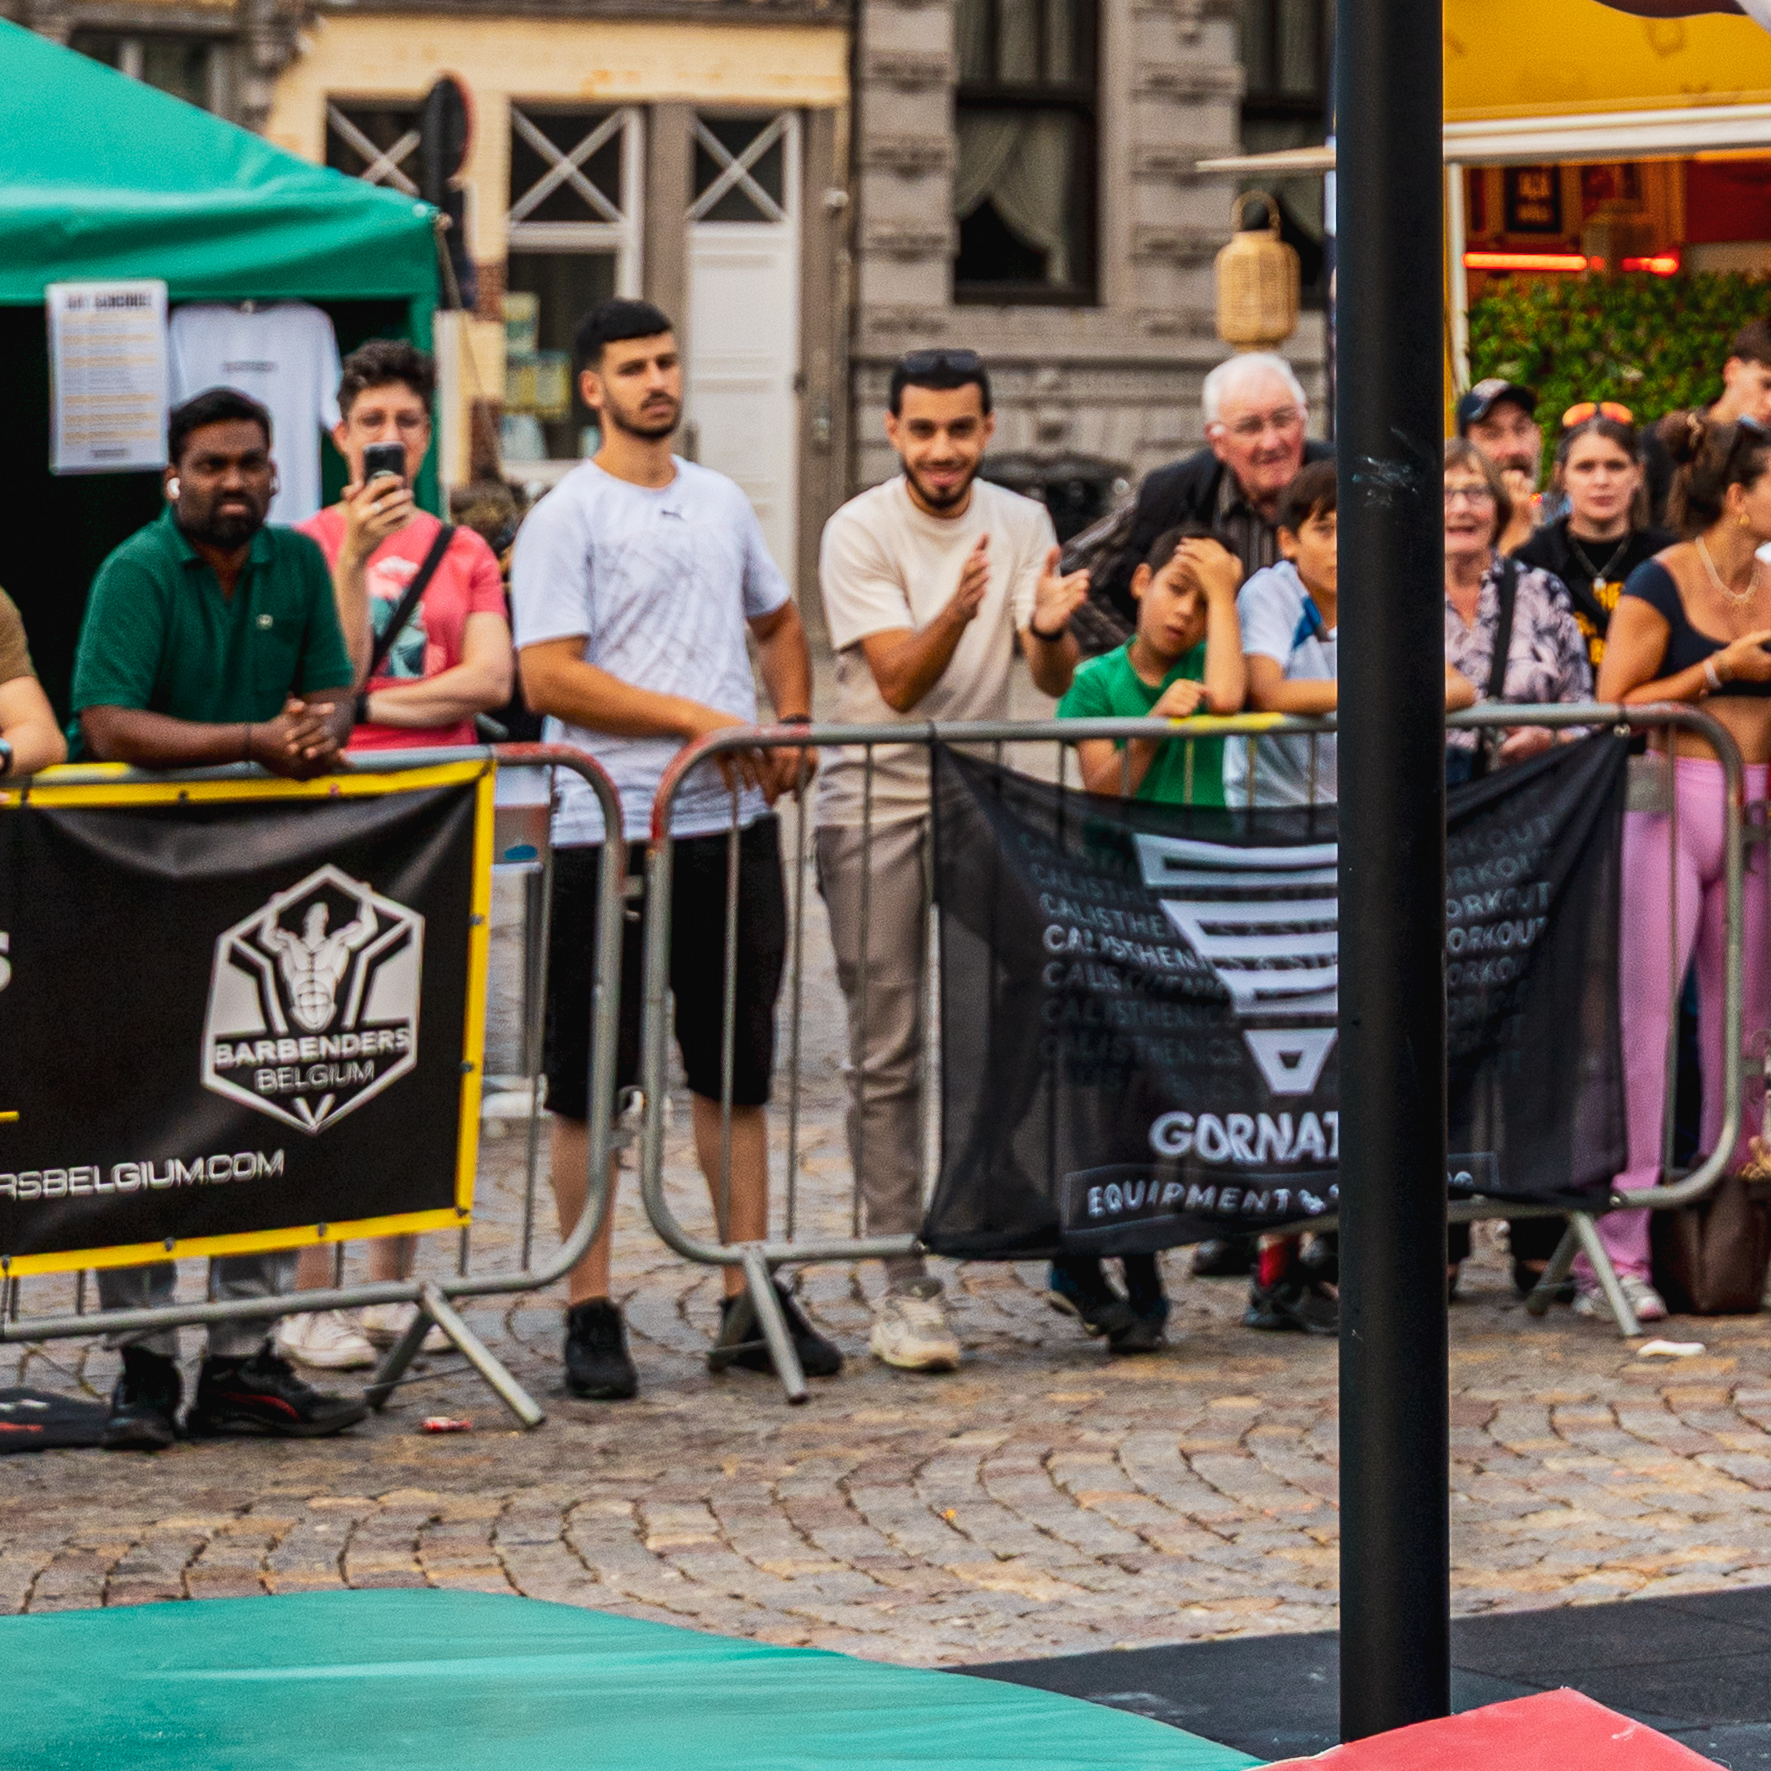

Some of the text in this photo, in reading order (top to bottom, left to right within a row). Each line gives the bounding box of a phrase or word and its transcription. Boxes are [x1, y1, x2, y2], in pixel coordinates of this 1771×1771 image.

[215, 1028, 411, 1068] BARBENDERS
[254, 1059, 376, 1095] BELGIUM
[1086, 1179, 1291, 1217] EQUIPMENT
